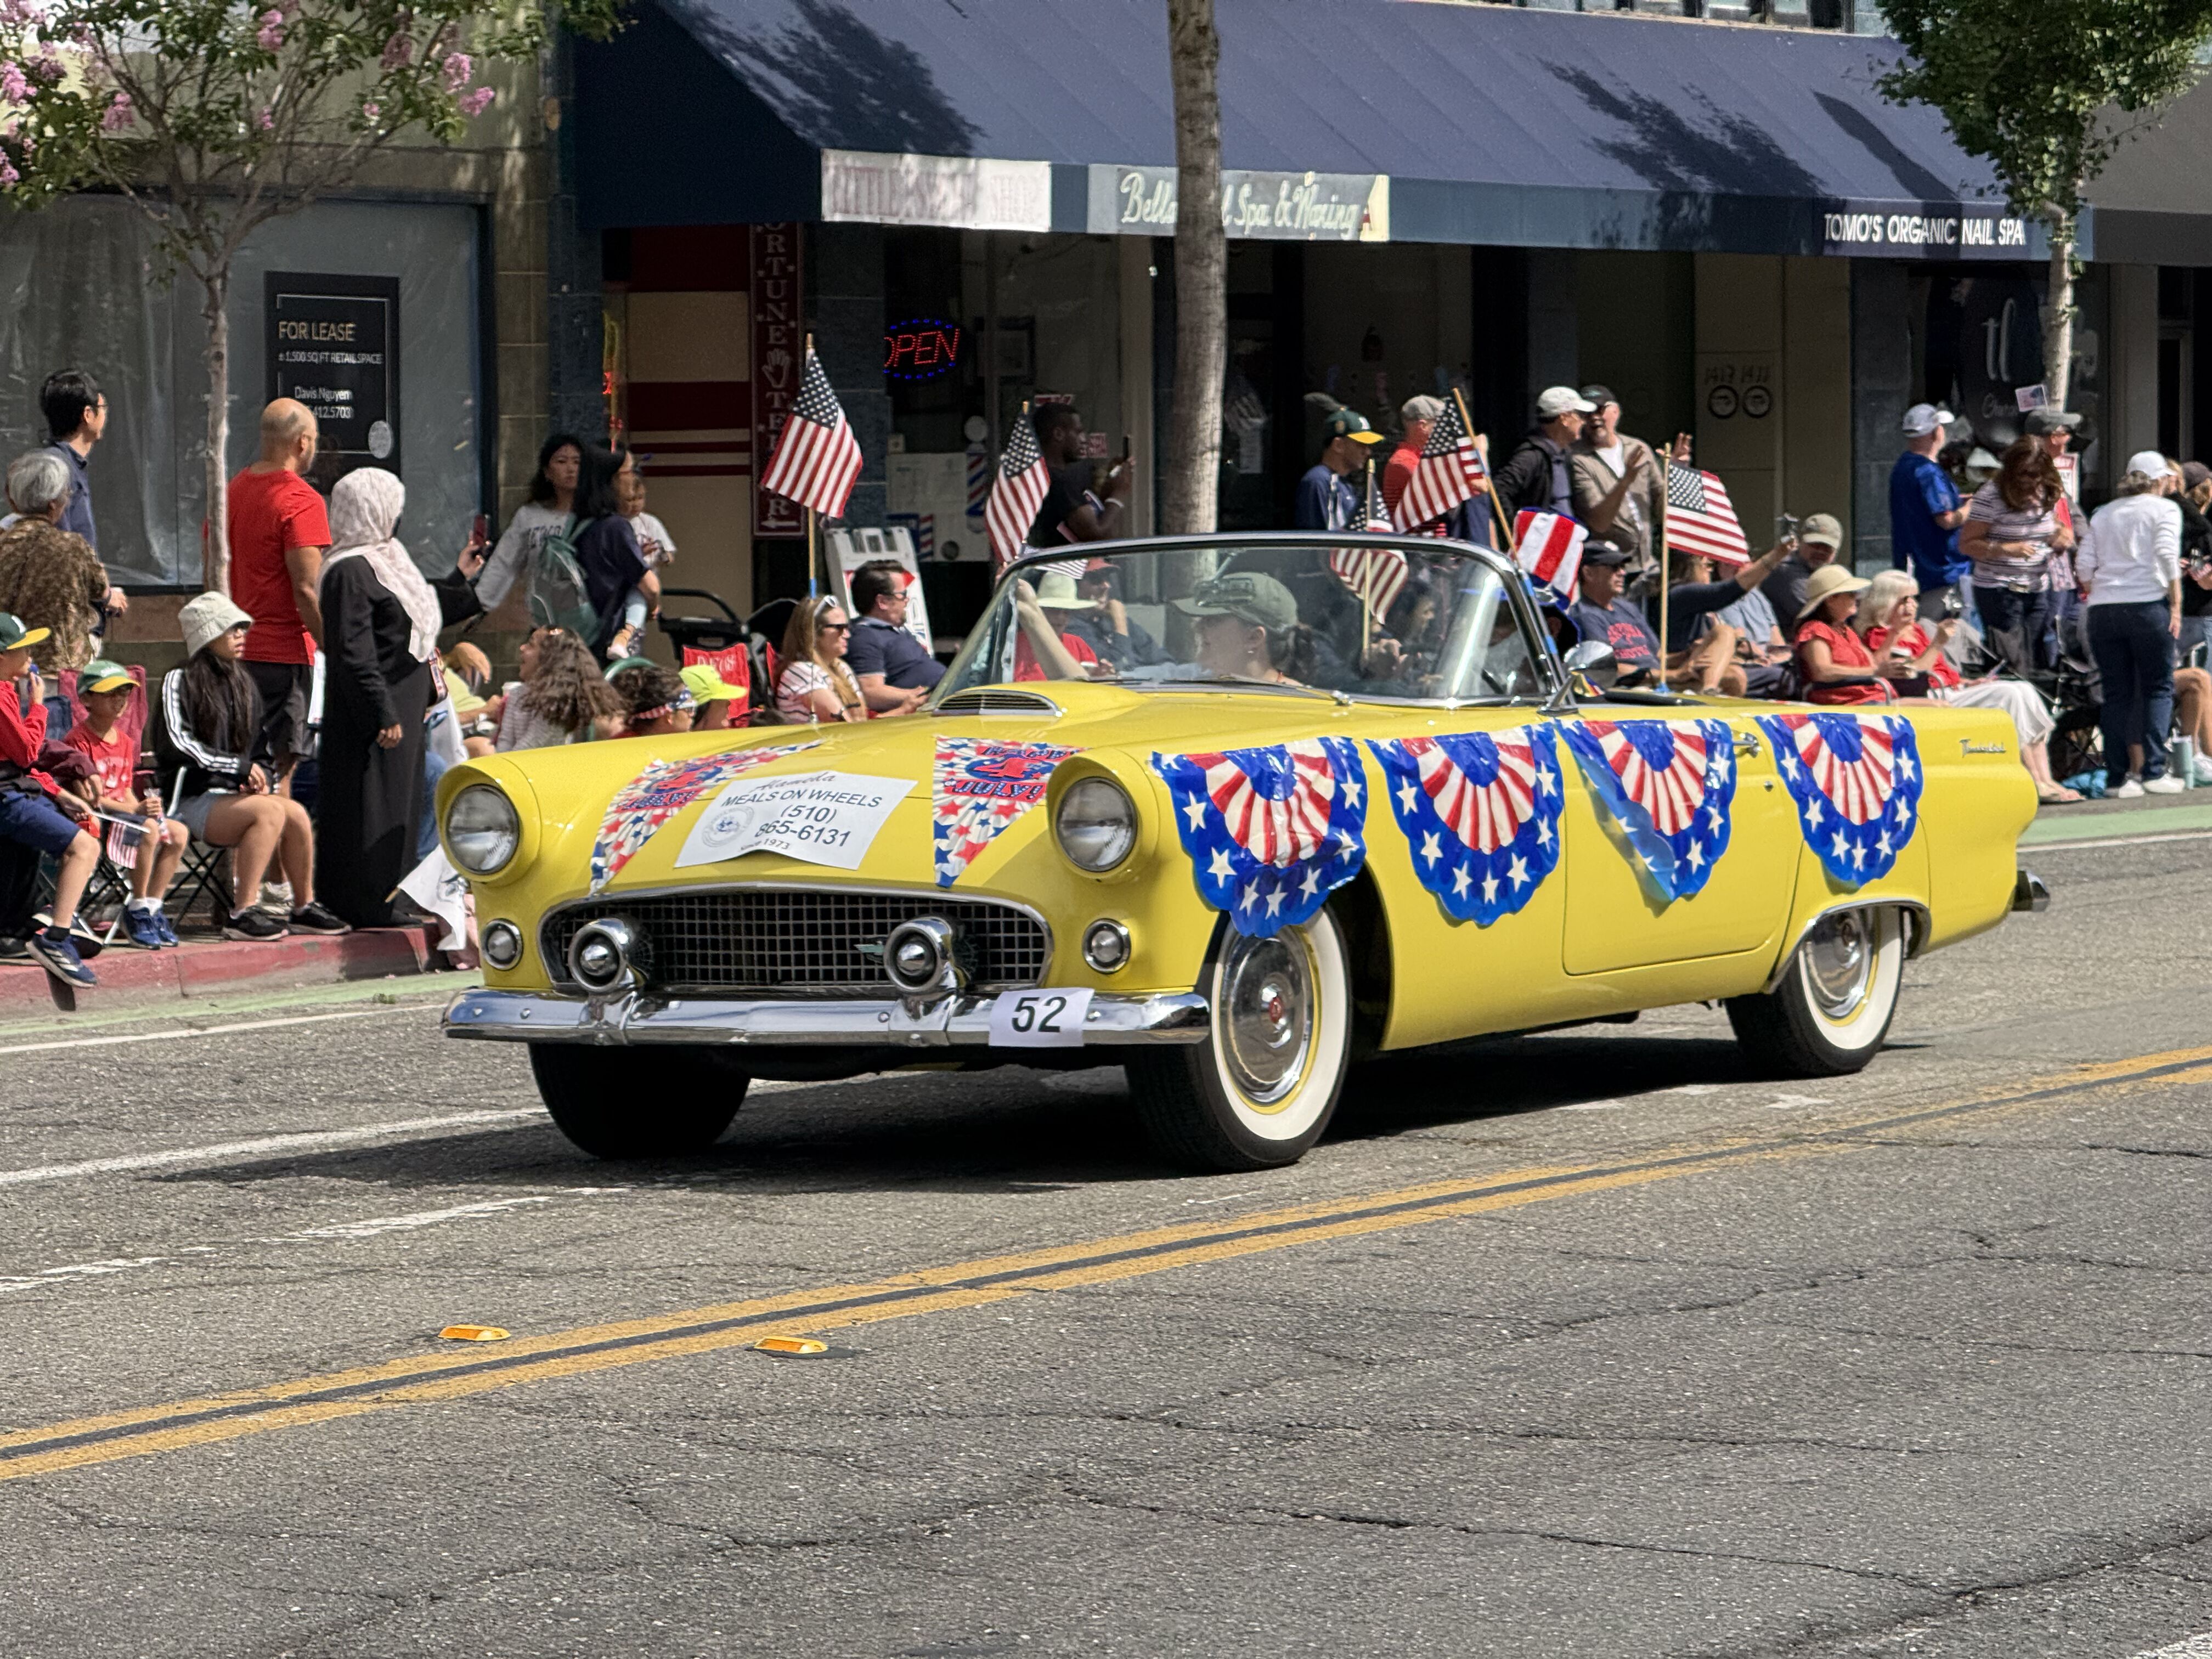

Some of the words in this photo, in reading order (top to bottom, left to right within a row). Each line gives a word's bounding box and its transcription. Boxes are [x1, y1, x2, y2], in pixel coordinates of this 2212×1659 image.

[1824, 213, 1884, 242] TOMO'S
[1887, 215, 1958, 245] ORGANIC
[1961, 217, 1995, 245] NAIL
[1998, 218, 2027, 245] SPA
[765, 222, 788, 345] RTUNE
[278, 321, 309, 340] FOR
[312, 322, 357, 342] LEASE
[331, 353, 357, 364] RETAIL
[357, 353, 383, 364] SPACE
[295, 386, 318, 399] Davis
[721, 790, 781, 807] MEALS
[780, 789, 804, 801] ON
[808, 789, 883, 808] WHEELS
[951, 780, 1044, 800] JULY!
[780, 804, 838, 824] (510)
[754, 820, 851, 848] 865-6131
[763, 838, 791, 850] 1973
[1011, 996, 1068, 1033] 52
